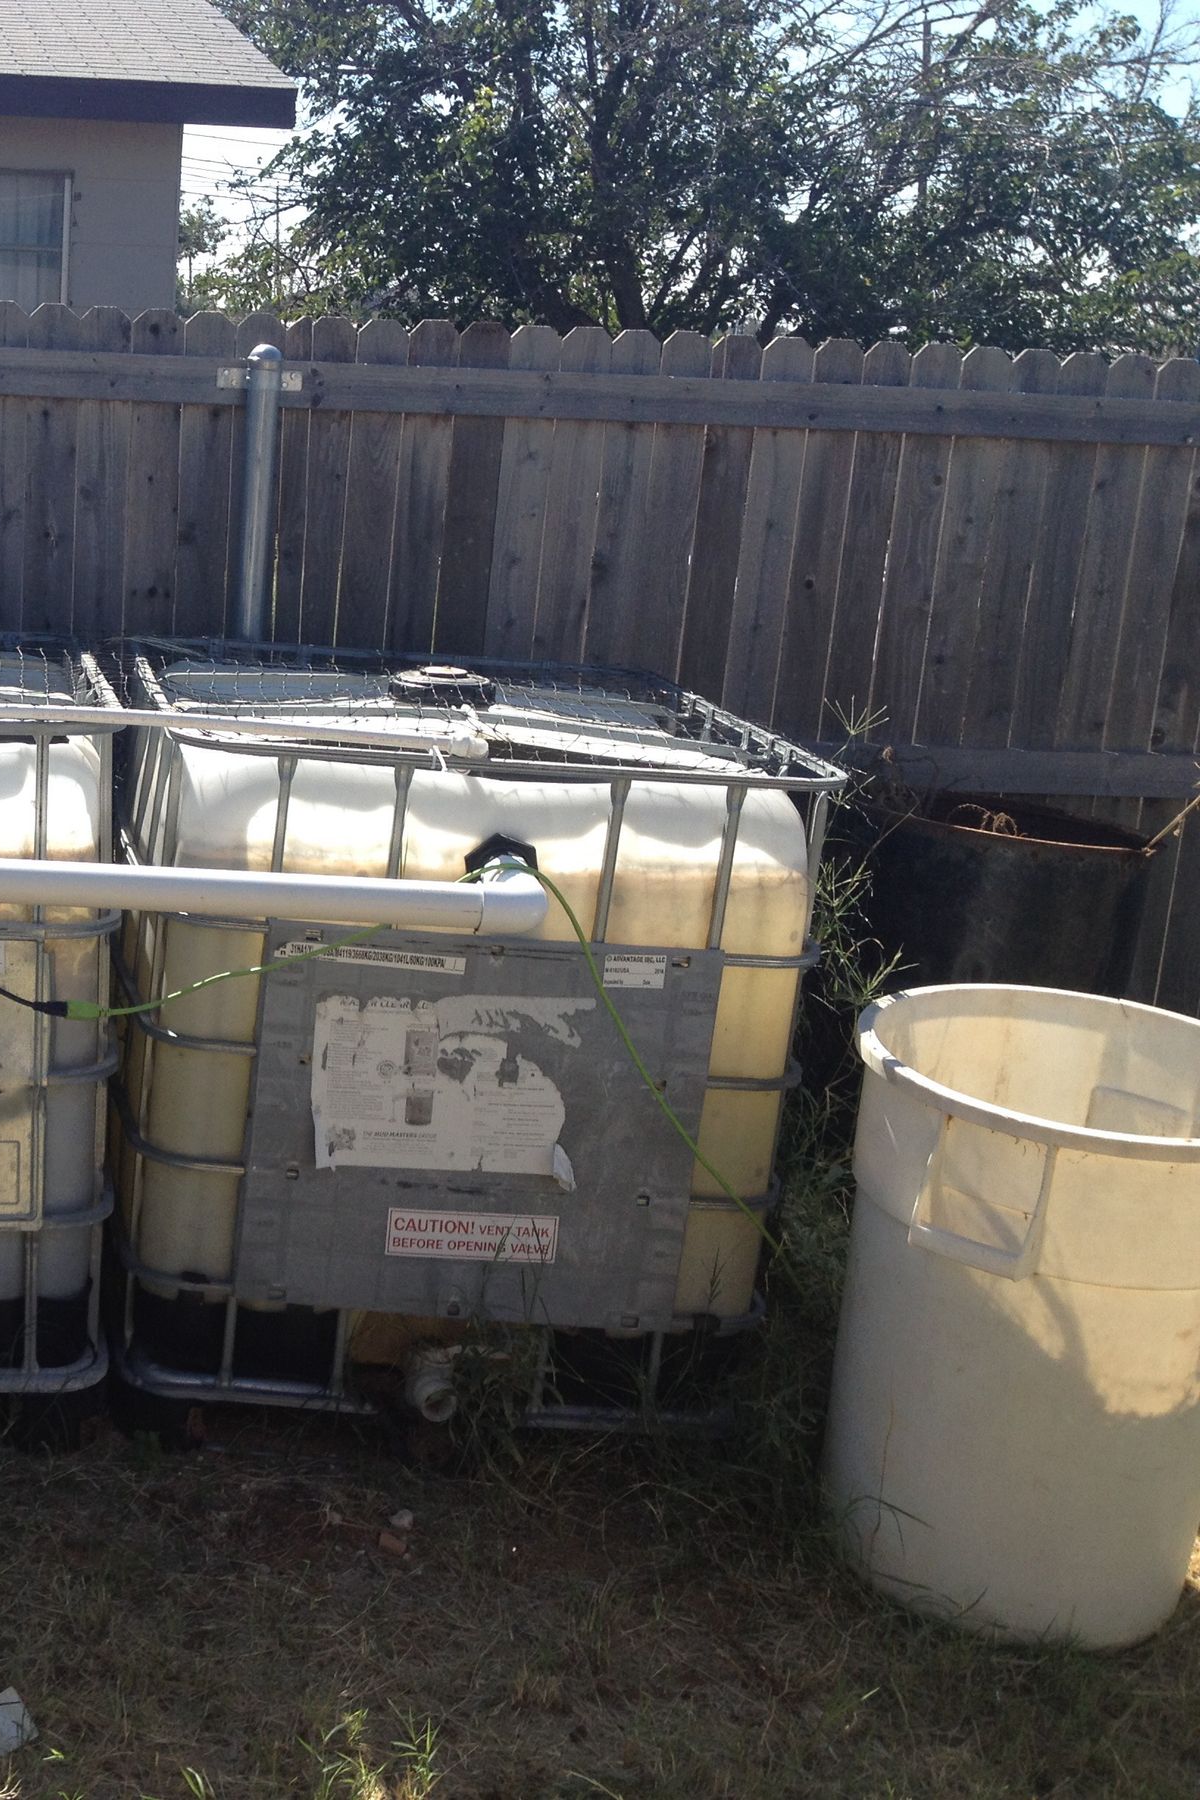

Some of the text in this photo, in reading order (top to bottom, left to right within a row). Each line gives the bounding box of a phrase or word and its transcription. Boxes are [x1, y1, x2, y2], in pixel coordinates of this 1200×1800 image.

[394, 1216, 550, 1238] CAUTION! VENT TANK
[392, 1236, 549, 1255] BEFORE OPENING VALVE
